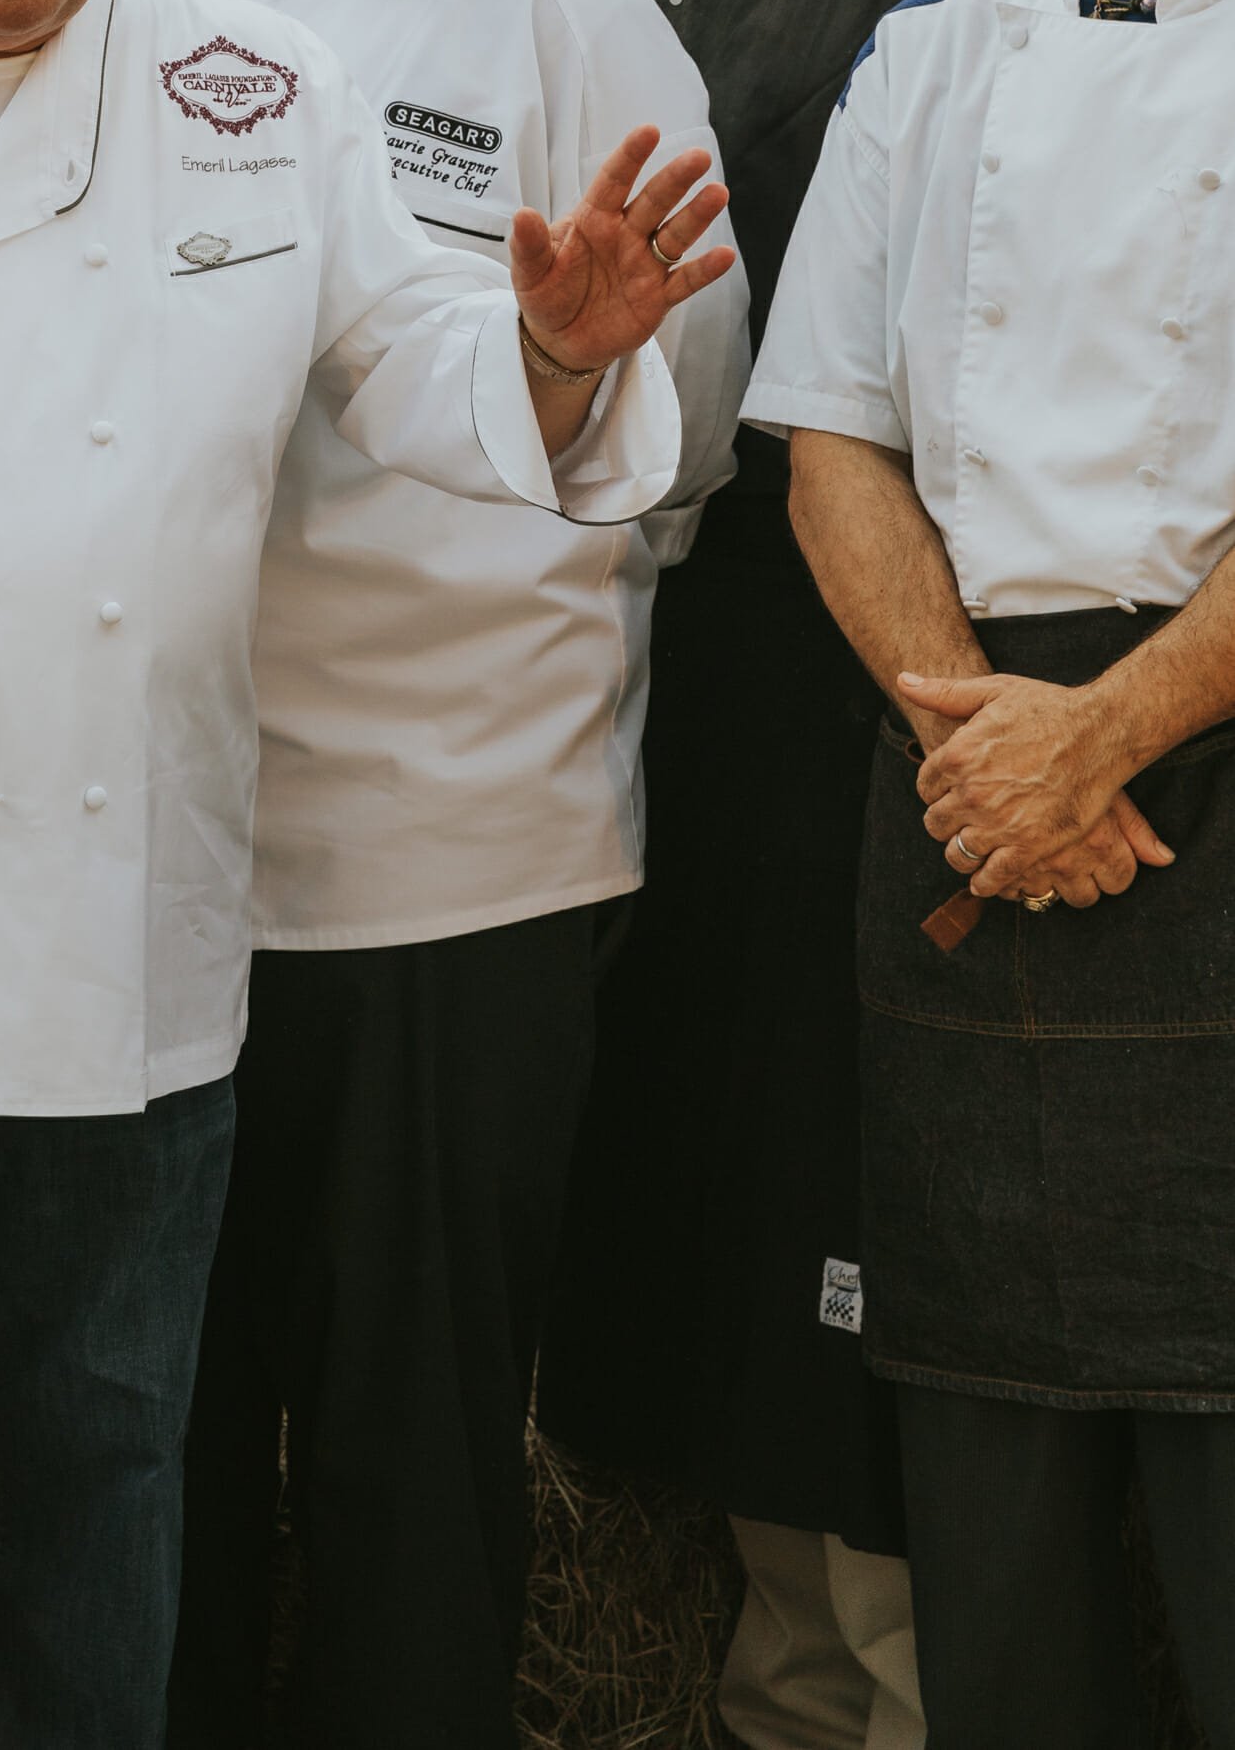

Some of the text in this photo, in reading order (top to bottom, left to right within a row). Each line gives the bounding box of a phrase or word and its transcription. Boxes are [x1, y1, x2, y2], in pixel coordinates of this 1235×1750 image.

[183, 80, 277, 94] CARNIVALE
[395, 108, 495, 148] SEAGAR'S
[181, 155, 297, 175] Emeril Lagasse
[385, 136, 499, 178] aurie Graupner
[390, 156, 451, 183] ecutive
[454, 175, 493, 199] Chef
